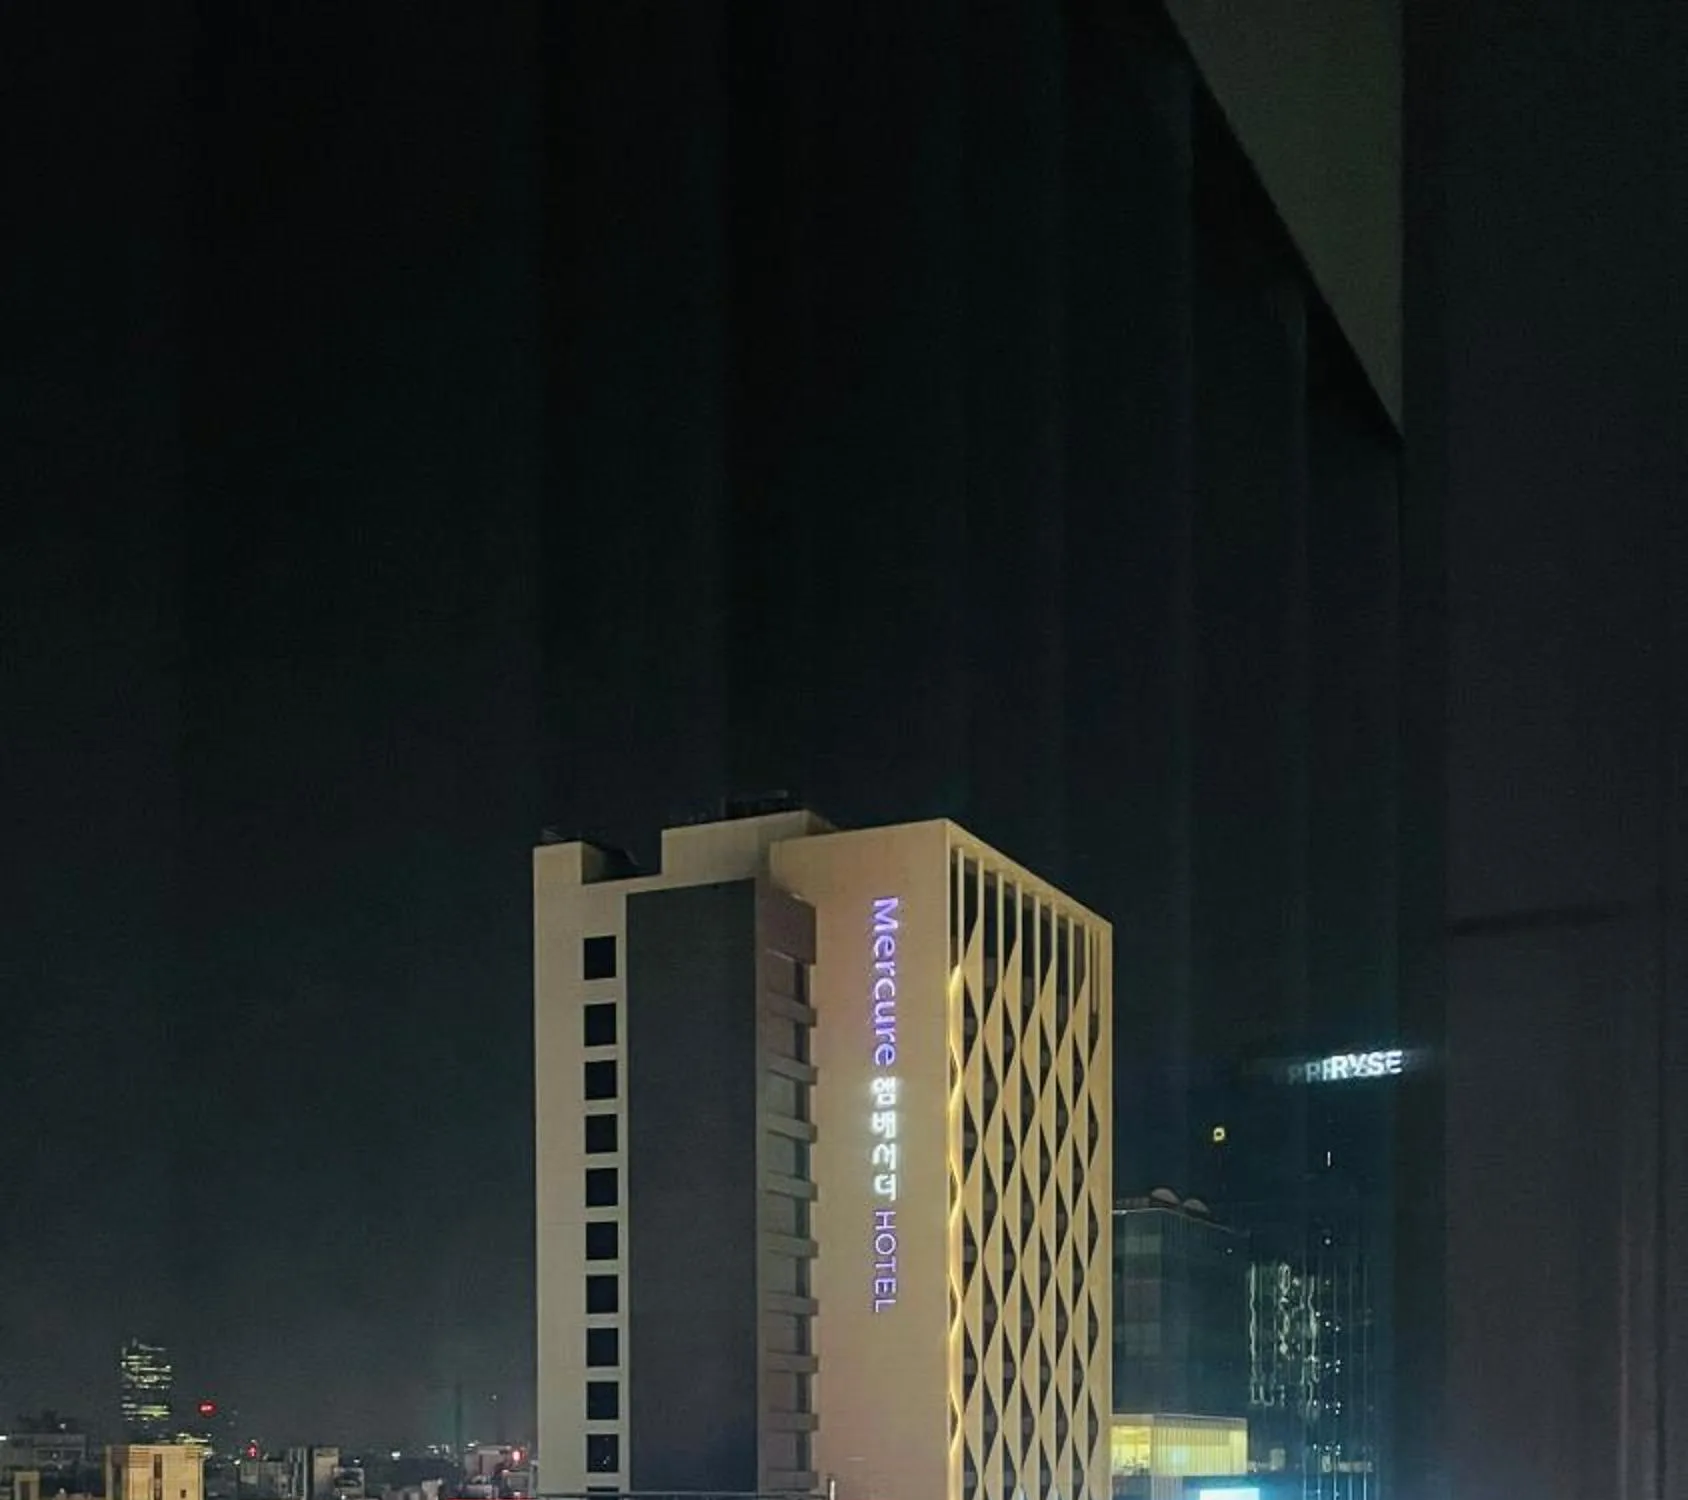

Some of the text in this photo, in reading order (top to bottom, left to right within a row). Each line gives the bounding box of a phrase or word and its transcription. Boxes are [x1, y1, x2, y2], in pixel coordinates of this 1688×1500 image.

[872, 896, 899, 1067] Mercure
[1330, 1050, 1404, 1080] RYSE
[874, 1210, 897, 1314] HOTEL
